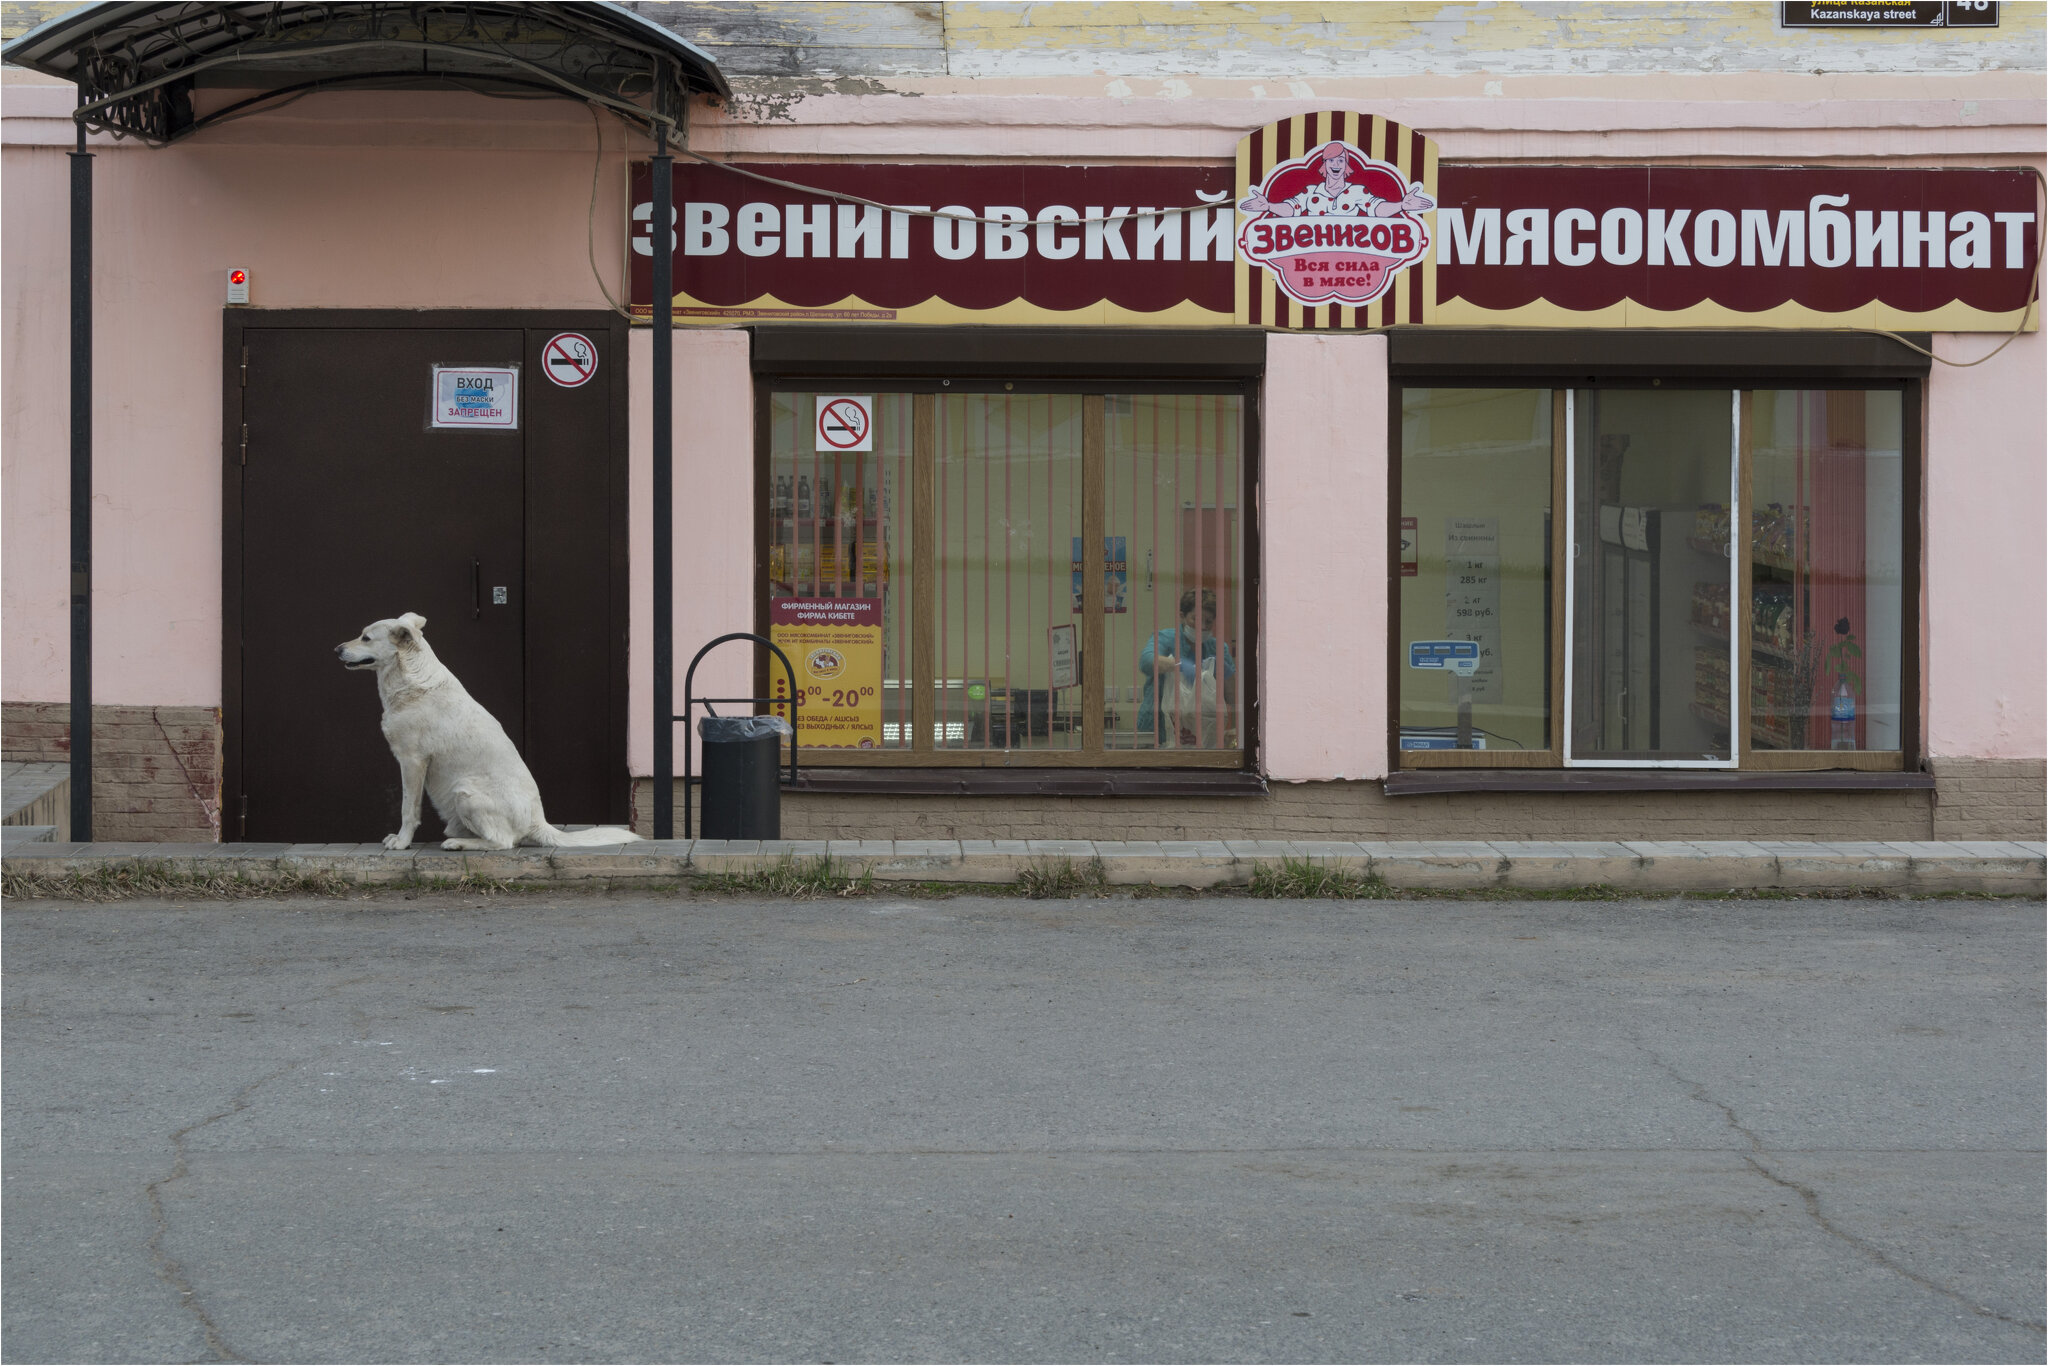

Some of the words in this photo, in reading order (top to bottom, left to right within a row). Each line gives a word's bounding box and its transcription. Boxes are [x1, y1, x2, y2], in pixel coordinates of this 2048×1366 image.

[1810, 9, 1881, 21] Kazanskaya
[1883, 9, 1917, 19] street
[1437, 193, 2035, 269] мясокомбинат
[1294, 258, 1329, 272] Вся
[1335, 260, 1380, 272] сила
[1303, 276, 1314, 287] в
[1319, 273, 1371, 287] мясе!
[457, 377, 494, 391] ВХОД
[448, 407, 502, 418] ЗАПРЕЩЕН
[1460, 576, 1476, 584] 285
[781, 602, 833, 610] ФИРМЕННЫЙ
[834, 603, 871, 611] МАГАЗИН
[828, 612, 855, 620] КИБЕТЕ
[1479, 648, 1493, 657] уб.
